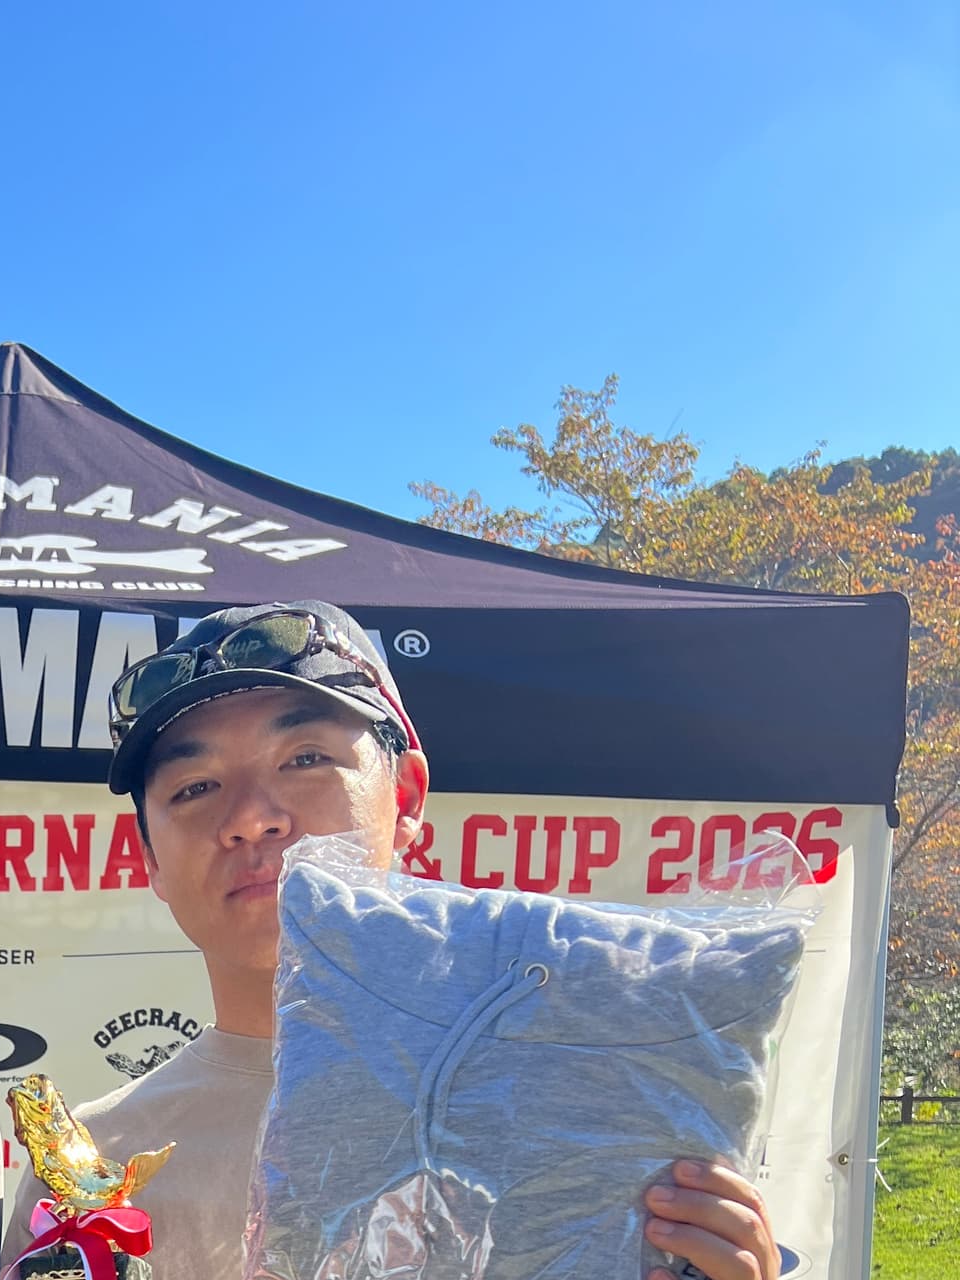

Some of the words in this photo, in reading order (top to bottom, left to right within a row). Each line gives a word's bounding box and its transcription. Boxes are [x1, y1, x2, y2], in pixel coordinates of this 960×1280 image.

[111, 580, 205, 591] CLUB
[460, 814, 621, 894] CUP
[646, 807, 843, 895] 2026
